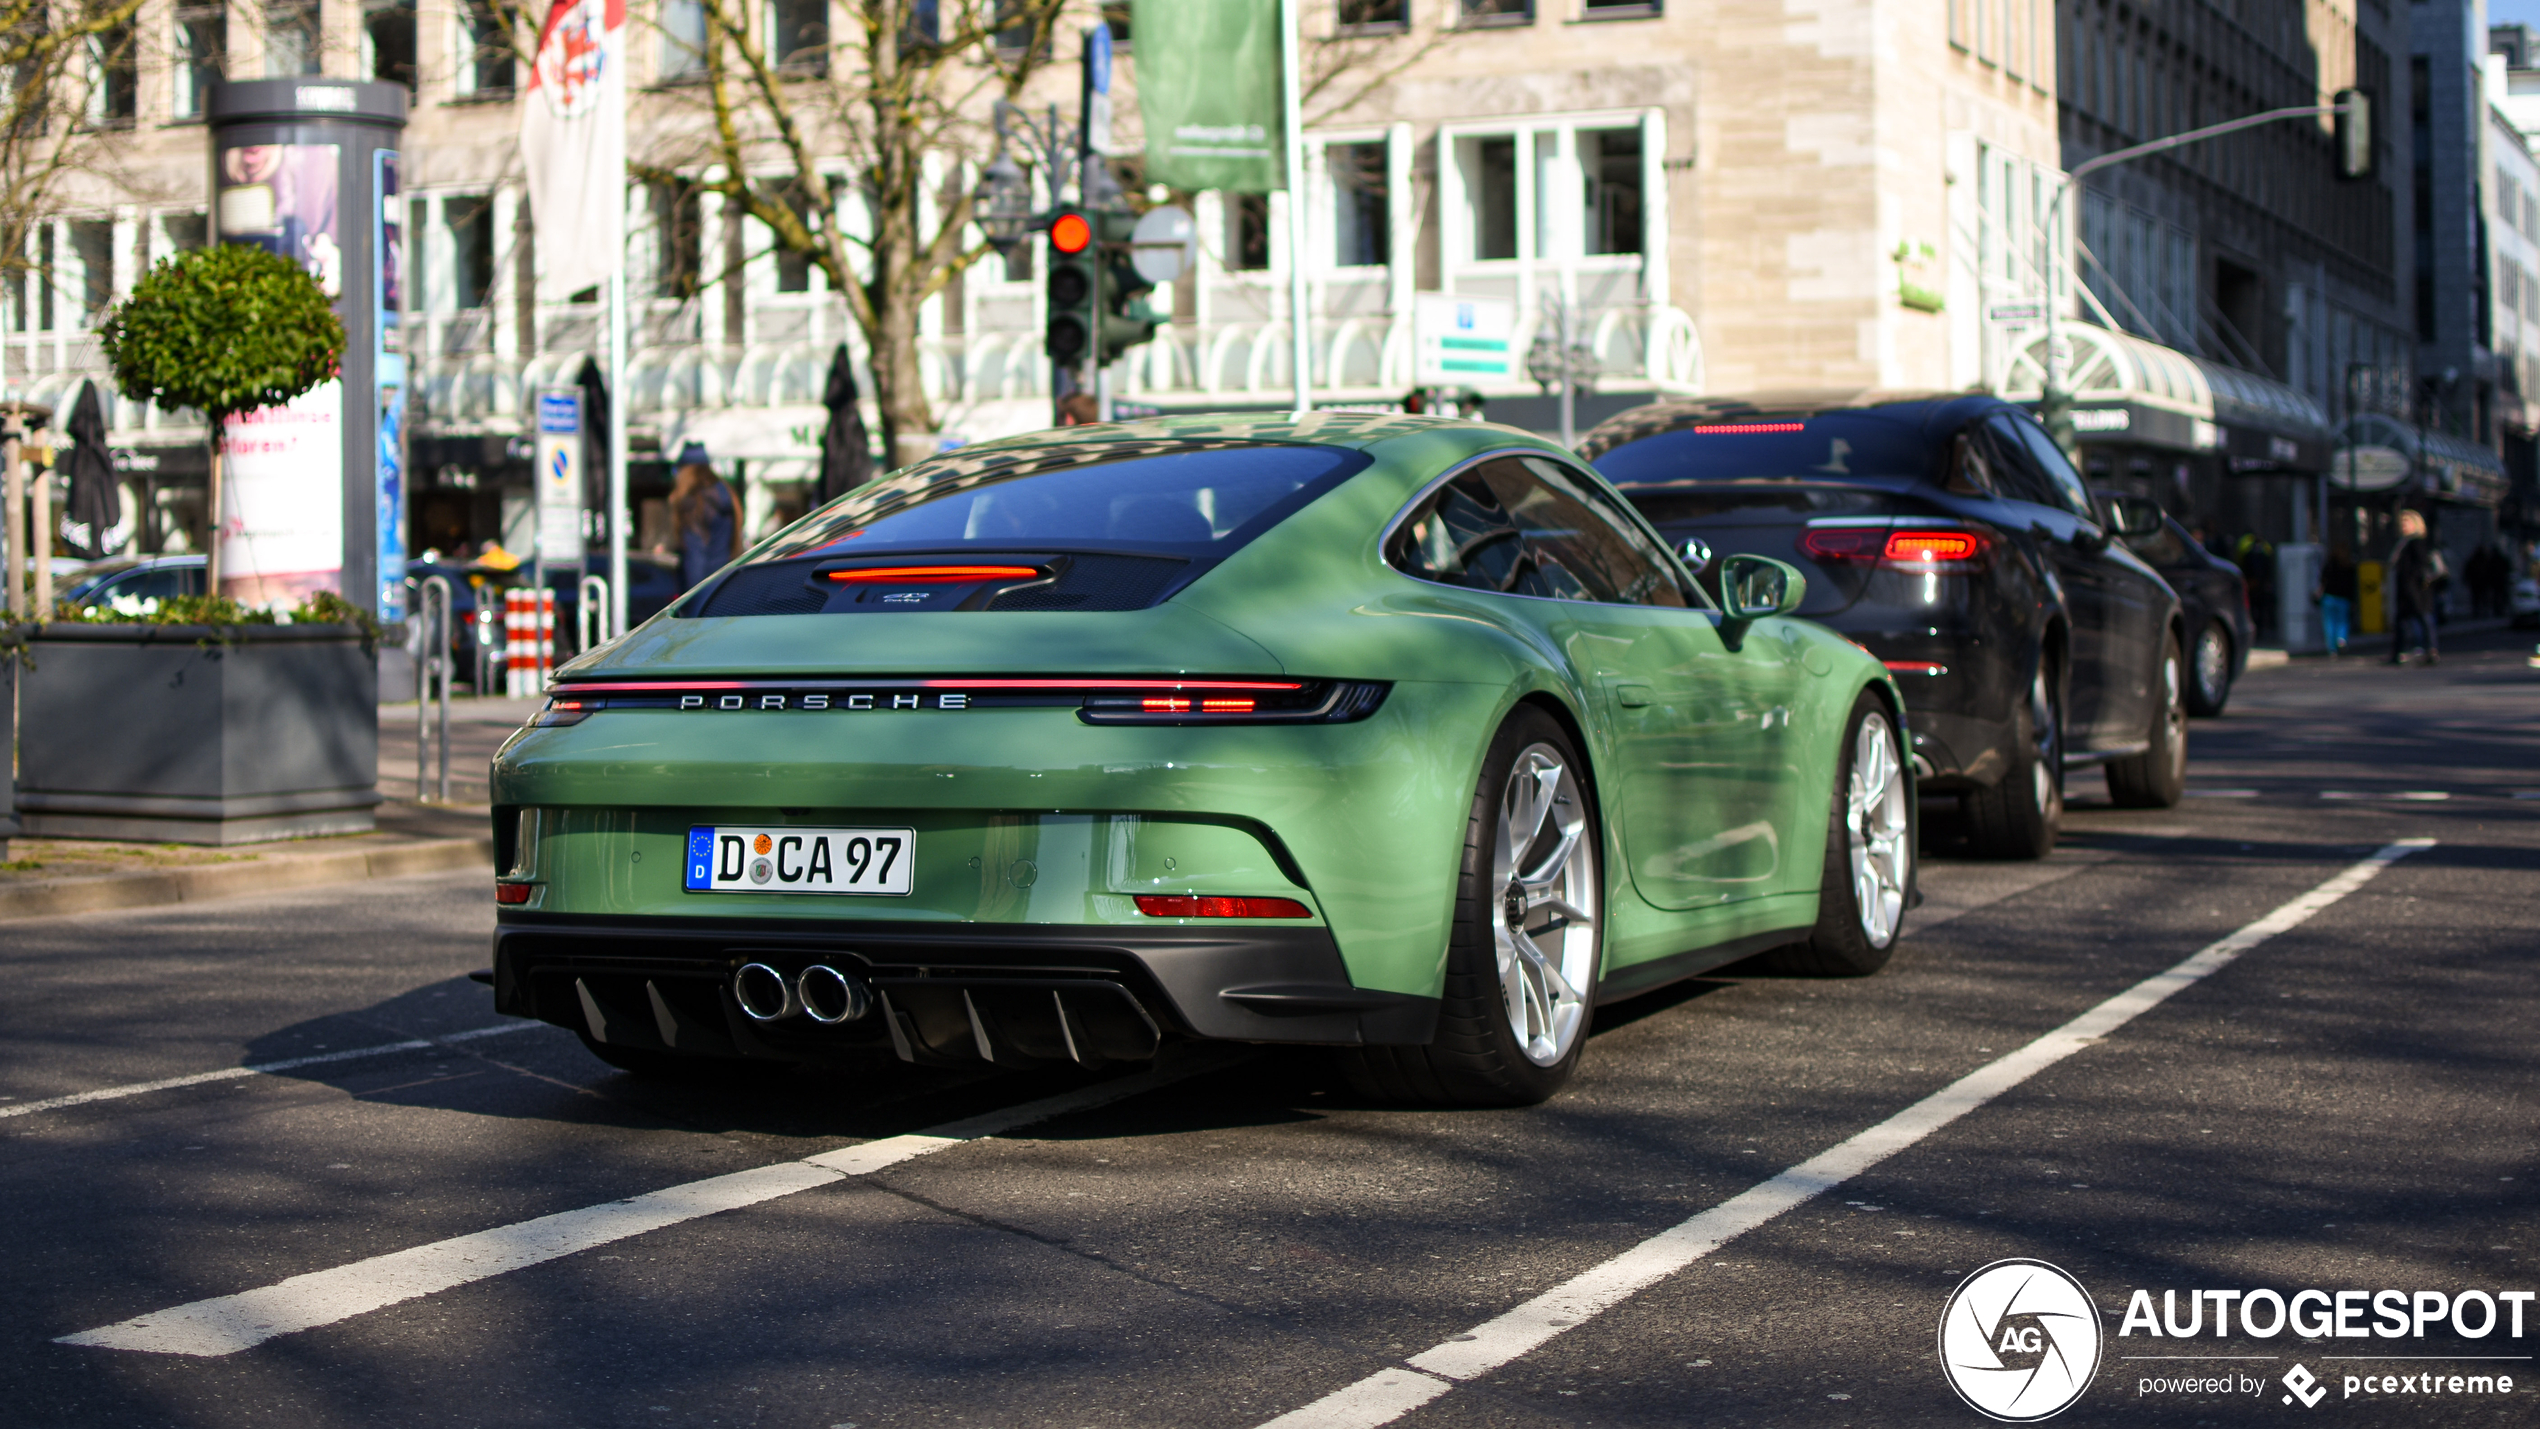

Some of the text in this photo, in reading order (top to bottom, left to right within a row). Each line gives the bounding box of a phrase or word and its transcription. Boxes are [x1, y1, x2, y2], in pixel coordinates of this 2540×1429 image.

[679, 694, 968, 711] PORSCHE
[717, 835, 746, 881] D
[777, 836, 833, 883] CA
[846, 837, 902, 884] 97
[695, 865, 705, 879] D
